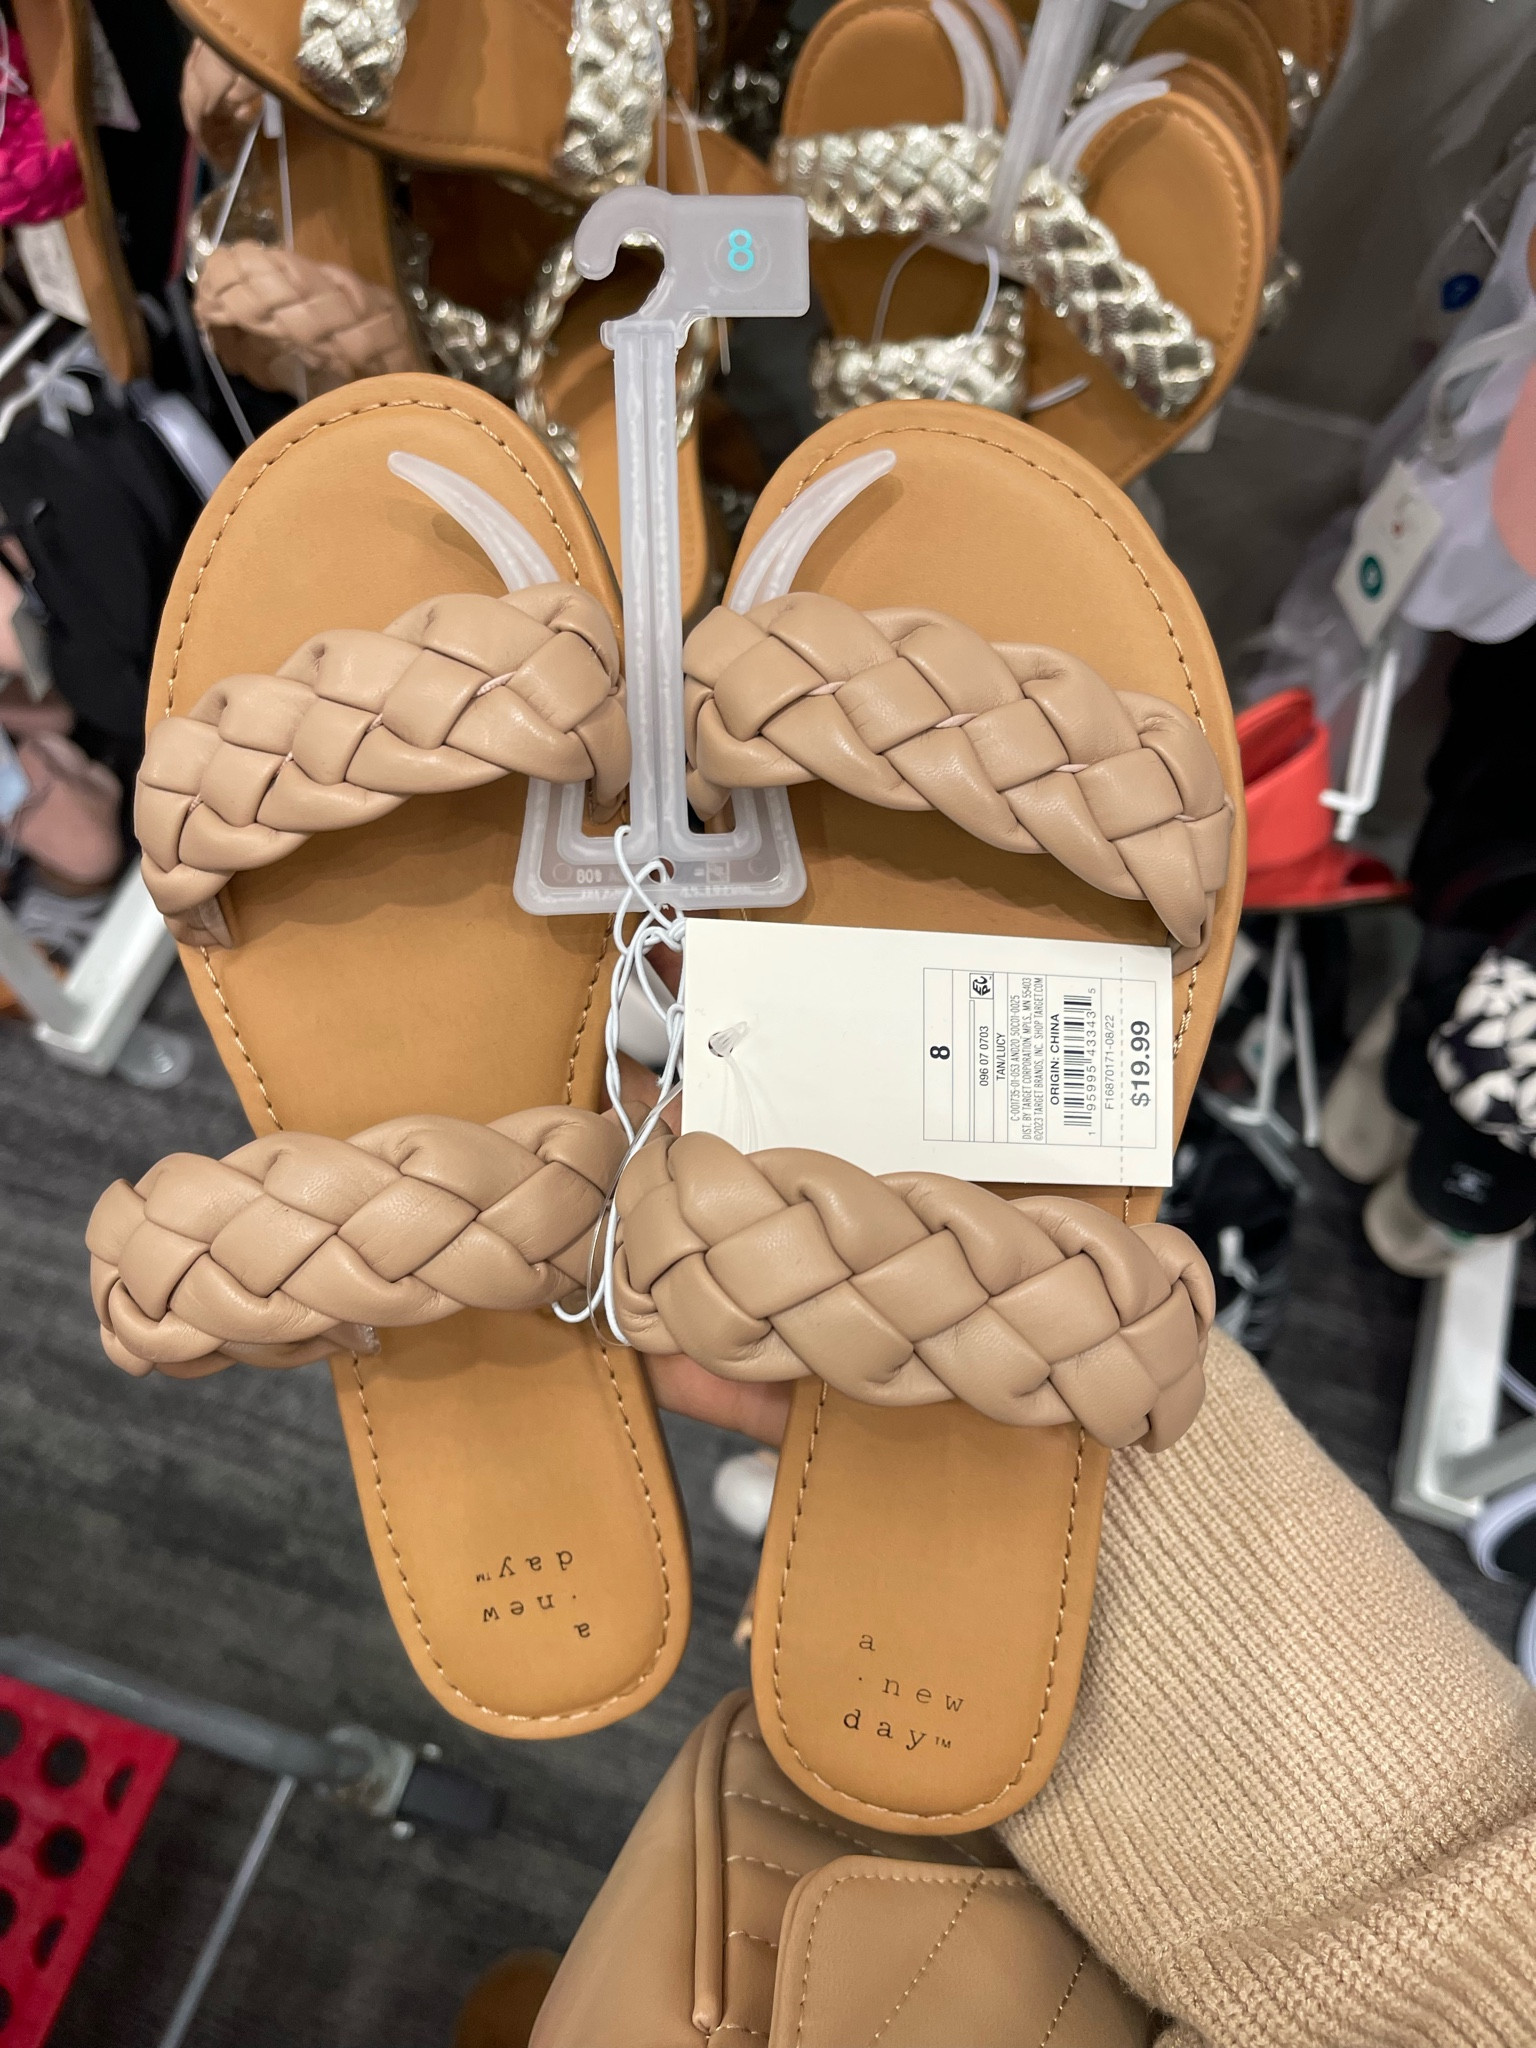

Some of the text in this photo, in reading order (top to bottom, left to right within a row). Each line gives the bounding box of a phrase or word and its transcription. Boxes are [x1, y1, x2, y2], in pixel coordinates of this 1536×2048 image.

[728, 227, 755, 272] 8
[1022, 977, 1032, 998] 55403
[1033, 977, 1044, 1018] TARGET.COM
[1022, 1000, 1032, 1011] MN
[1033, 1020, 1044, 1040] SHOP
[929, 1045, 951, 1060] 8
[979, 1026, 989, 1087] 096 07 0703
[996, 1032, 1006, 1081] TAN/LUCY
[1034, 1043, 1043, 1057] INC.
[1050, 1013, 1060, 1105] ORIGIN: CHINA
[1104, 1014, 1115, 1110] F16870171-08/22
[1129, 1020, 1151, 1107] $19.99
[1022, 1086, 1031, 1110] TARGET
[1034, 1091, 1043, 1115] TARGET
[1022, 1113, 1031, 1121] BY
[1022, 1123, 1032, 1140] DIST.
[573, 1622, 590, 1639] a
[858, 1634, 876, 1651] a
